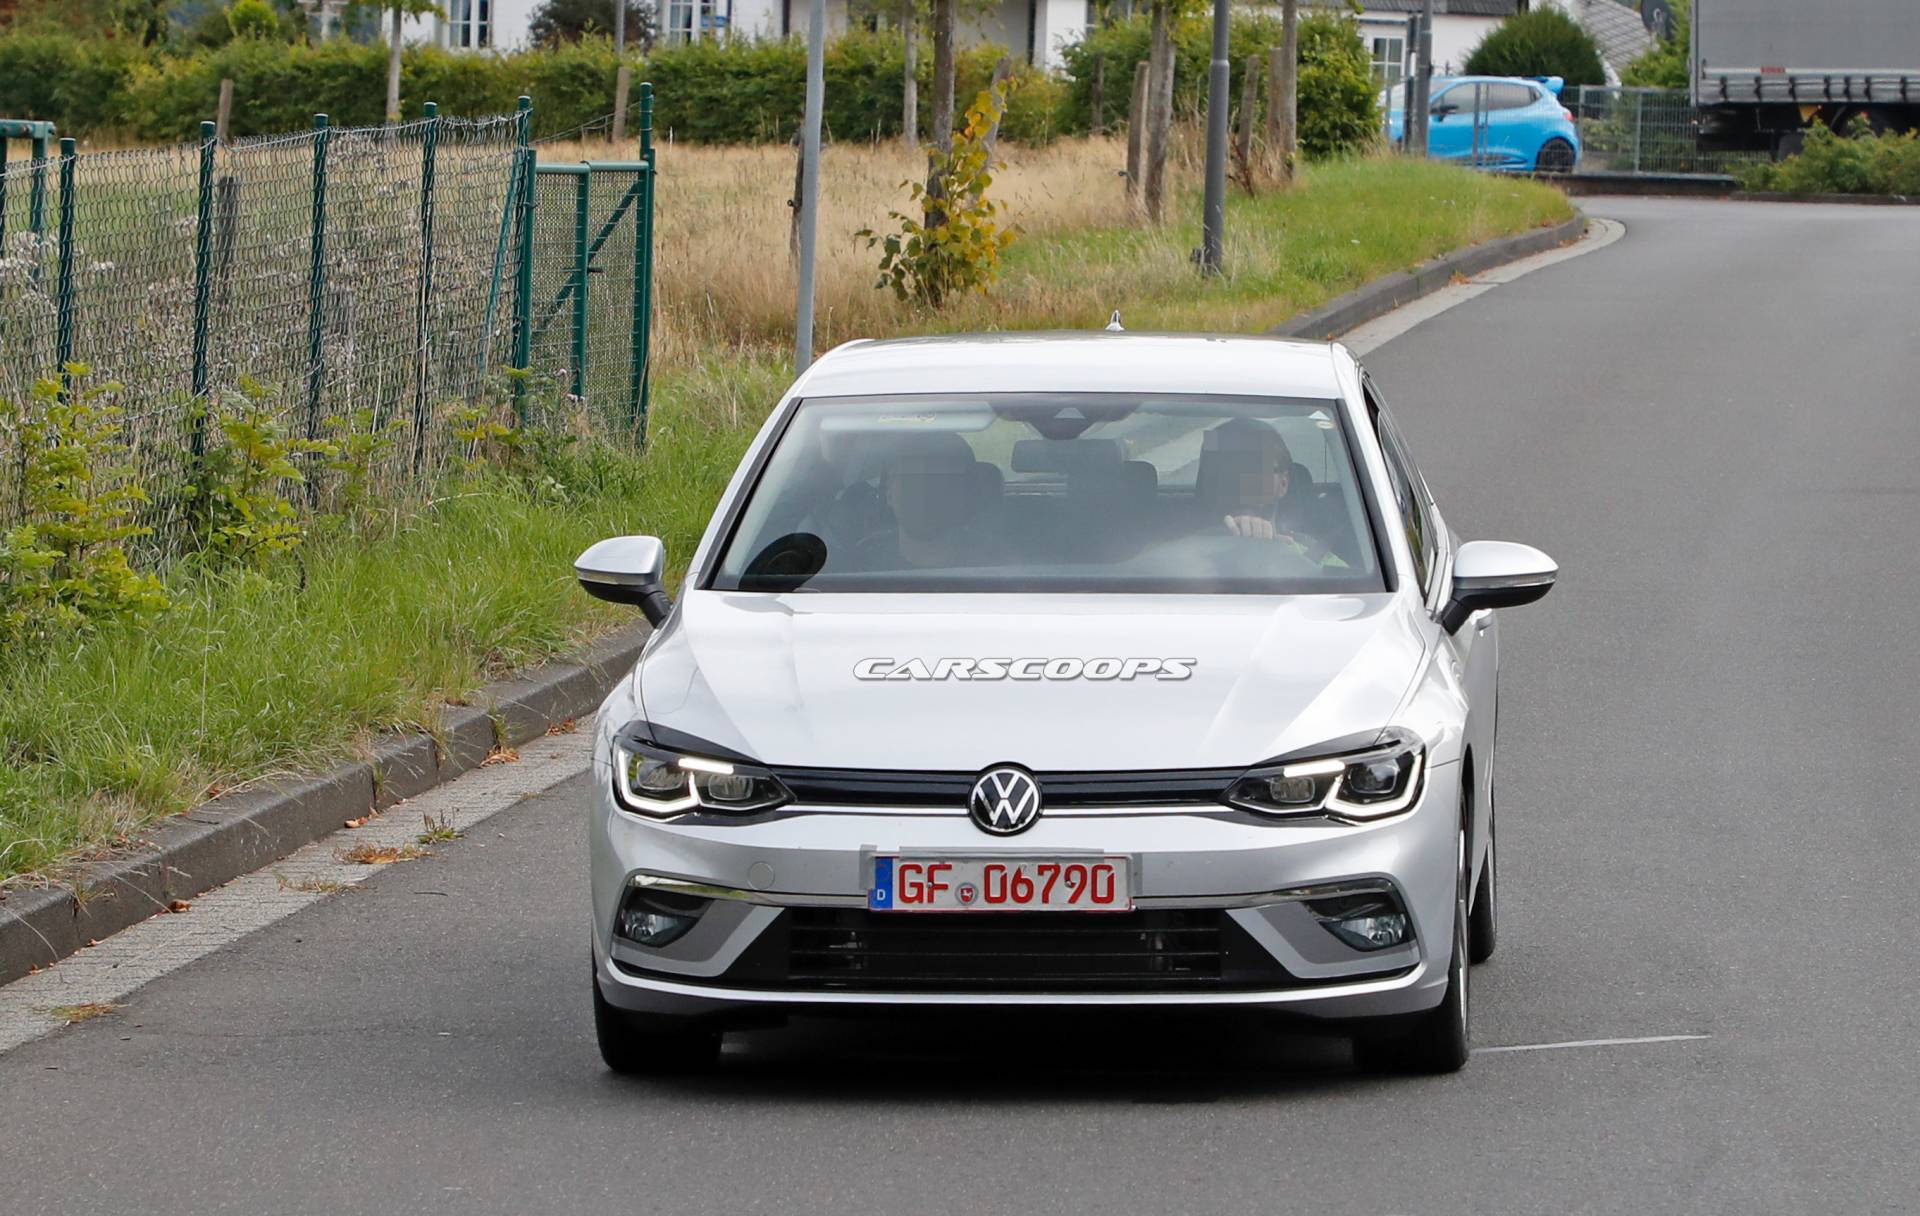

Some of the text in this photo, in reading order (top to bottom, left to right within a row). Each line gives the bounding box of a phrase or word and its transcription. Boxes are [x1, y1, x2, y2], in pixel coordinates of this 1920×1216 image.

[973, 769, 1037, 828] VW
[876, 864, 1115, 904] D GF 06790
